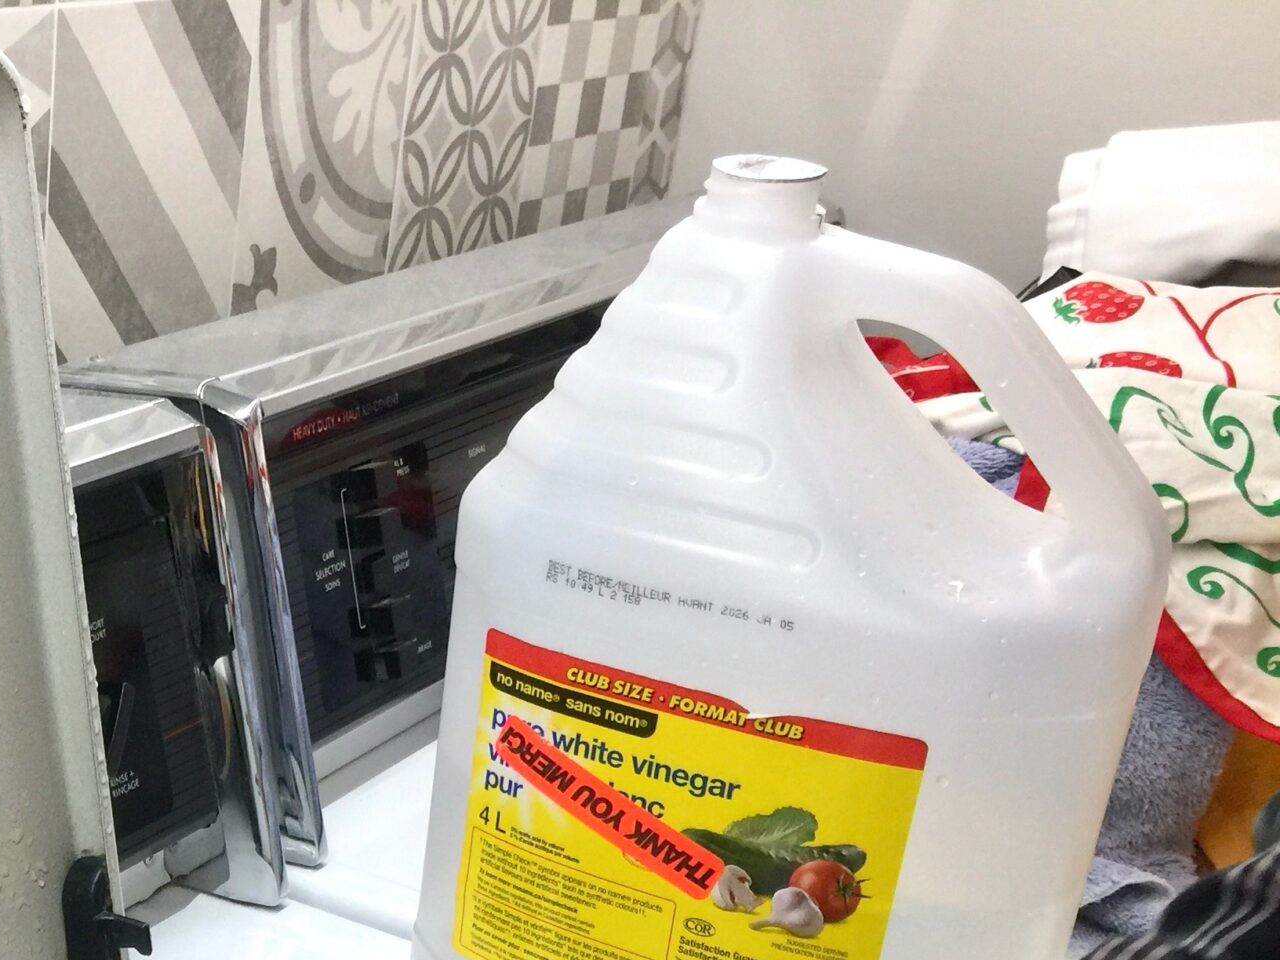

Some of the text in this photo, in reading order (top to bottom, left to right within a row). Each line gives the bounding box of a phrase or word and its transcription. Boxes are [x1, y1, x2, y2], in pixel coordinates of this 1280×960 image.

[496, 670, 513, 688] no
[565, 697, 602, 717] sans
[566, 667, 805, 740] CLUB SIZE FORMAT CLUB
[484, 769, 524, 799] pur
[500, 726, 577, 794] MERCI
[552, 732, 624, 769] white
[631, 754, 741, 800] vinegar
[478, 806, 506, 834] 4 L
[570, 784, 626, 832] YOU
[624, 819, 716, 890] THANK
[679, 936, 731, 959] Satisfaction
